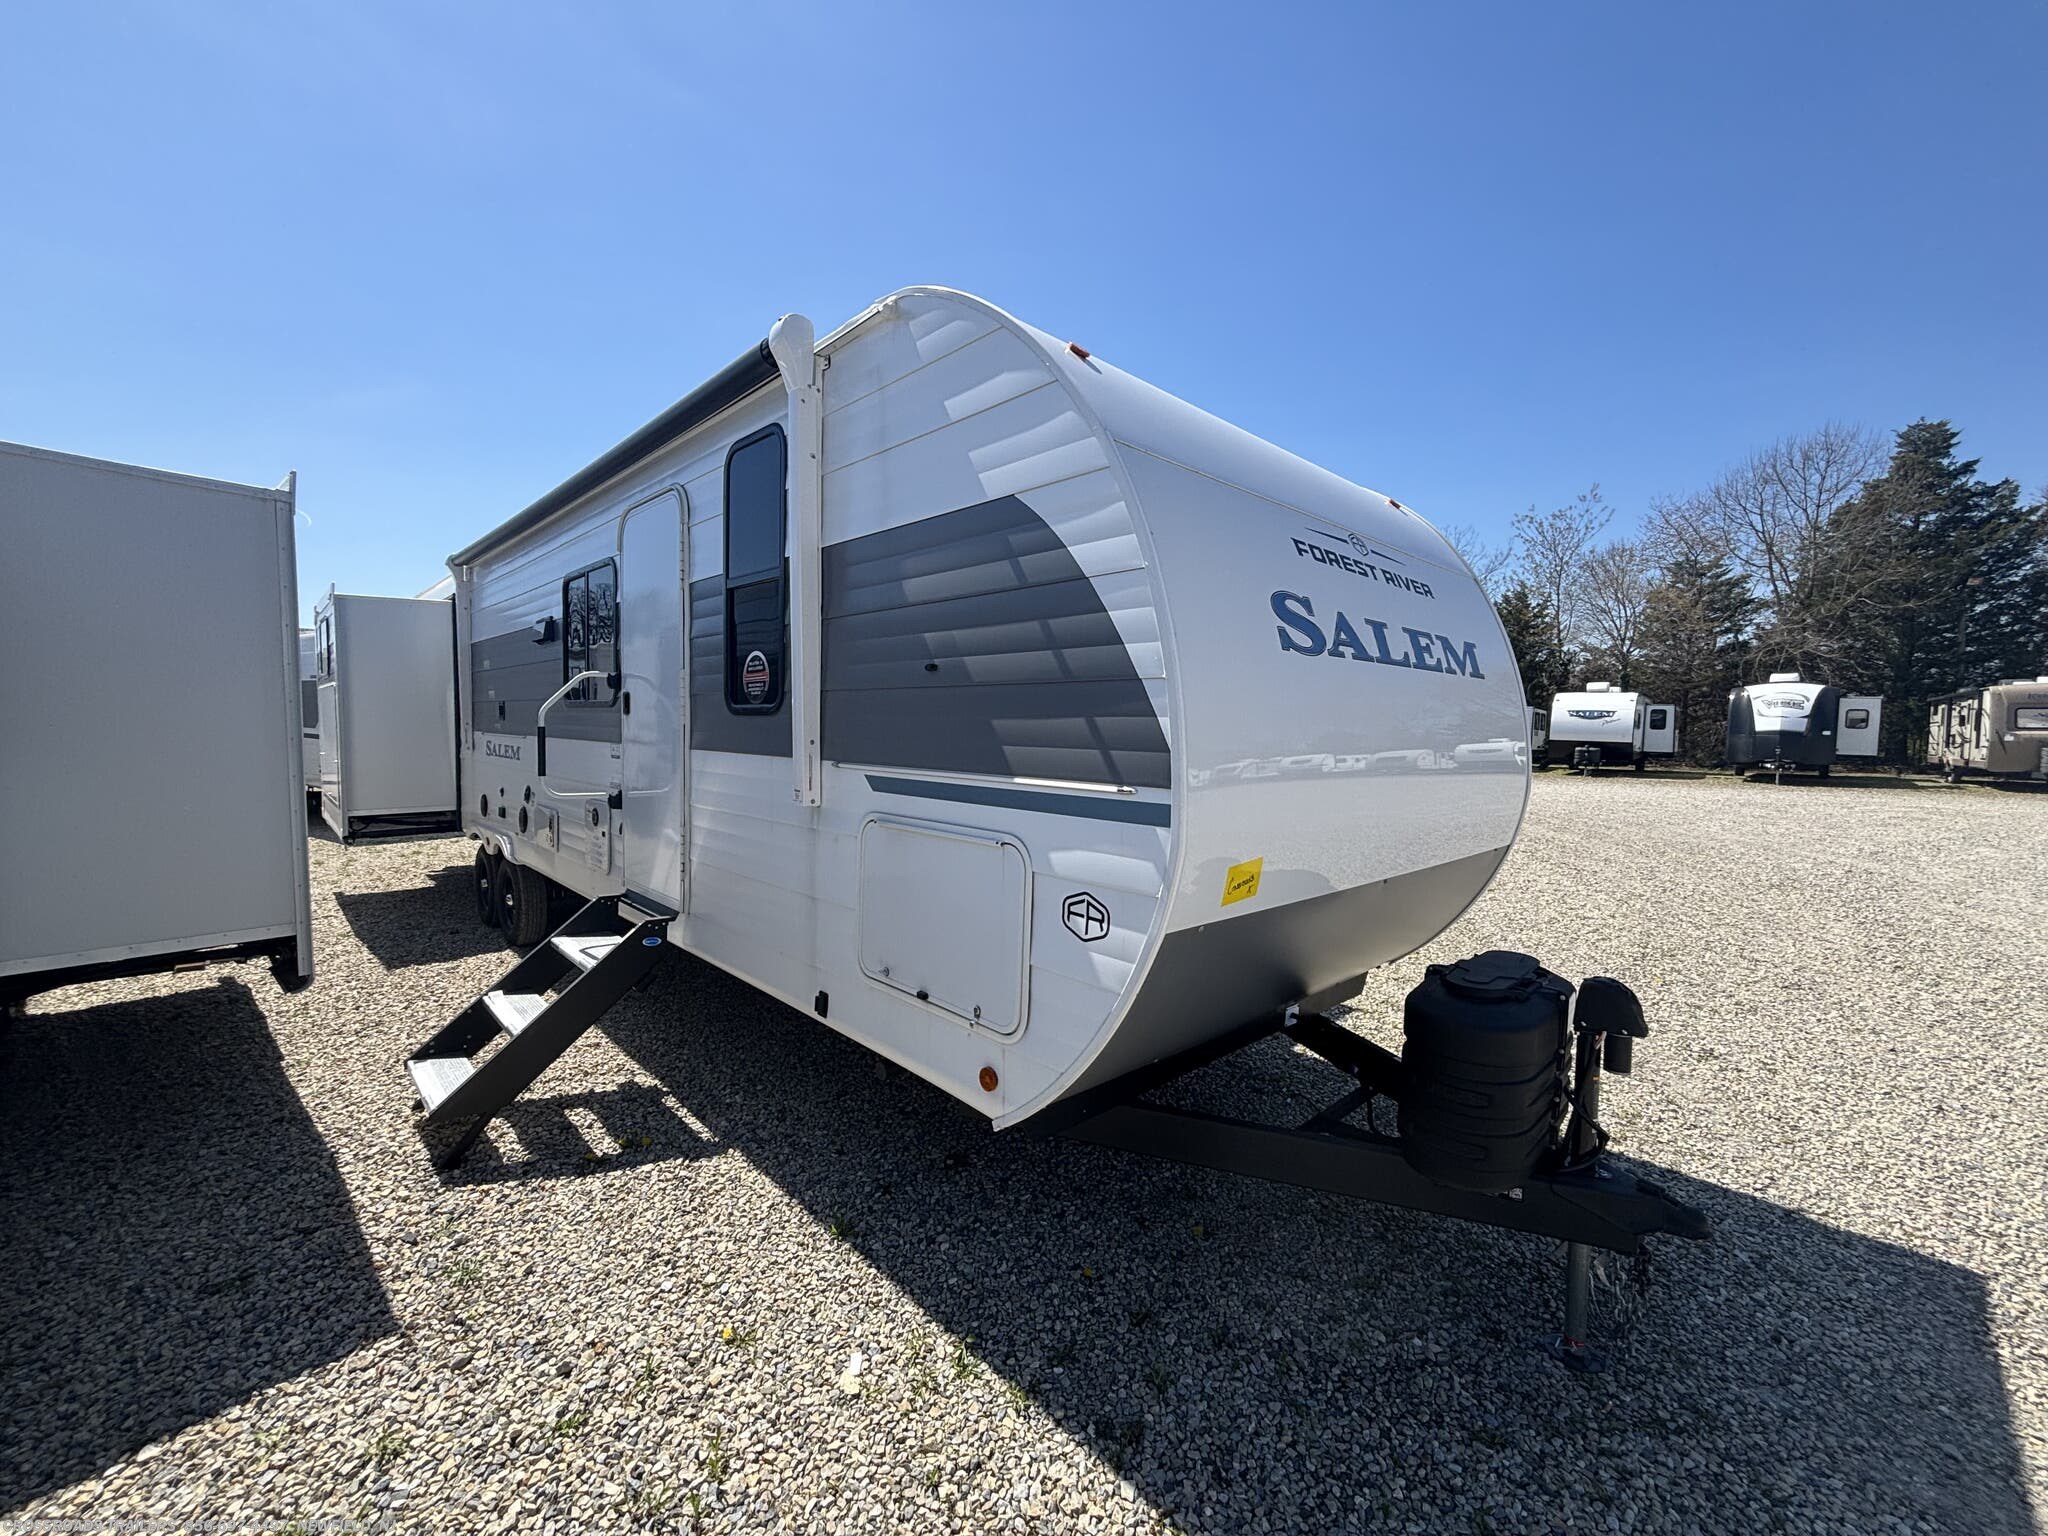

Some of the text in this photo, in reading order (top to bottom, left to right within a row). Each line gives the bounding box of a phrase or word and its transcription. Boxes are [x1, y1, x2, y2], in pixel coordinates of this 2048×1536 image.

[1290, 537, 1435, 600] FOREST RIVER
[1270, 590, 1485, 680] SALEM
[486, 740, 521, 760] SALEM
